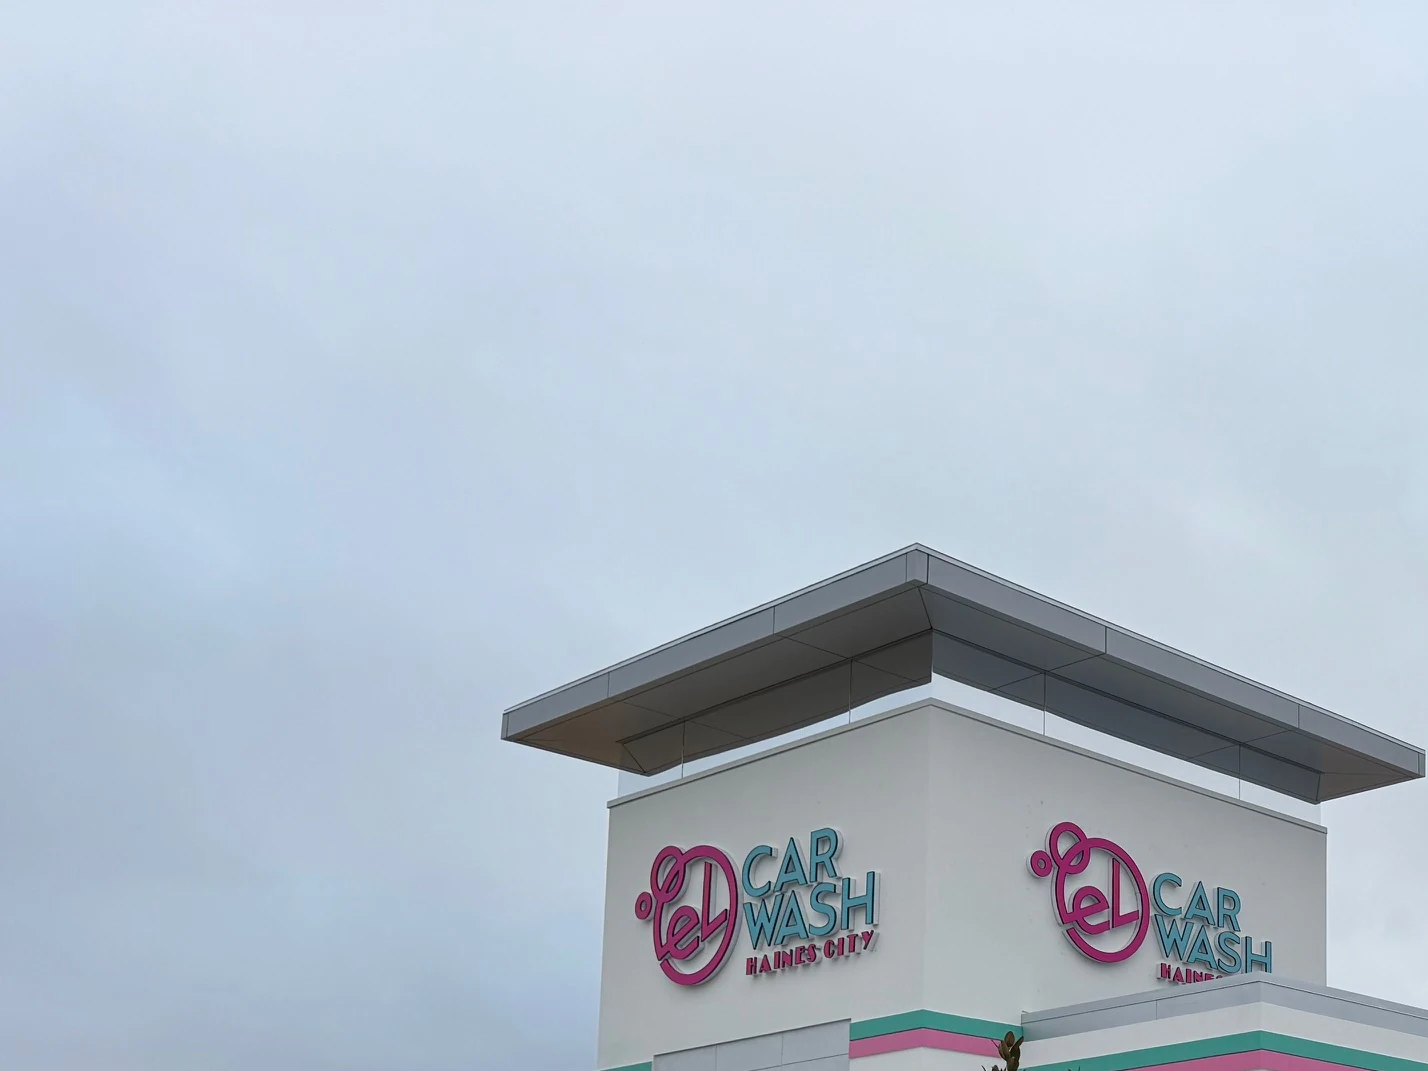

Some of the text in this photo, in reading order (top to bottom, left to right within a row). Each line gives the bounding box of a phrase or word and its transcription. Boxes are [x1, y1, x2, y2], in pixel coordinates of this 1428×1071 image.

[742, 827, 839, 899] CAR
[743, 871, 876, 951] WASH
[1152, 872, 1242, 932] CAR
[745, 929, 875, 976] HAINES CITY
[1154, 914, 1273, 974] WASH
[1160, 963, 1223, 984] HAINE
